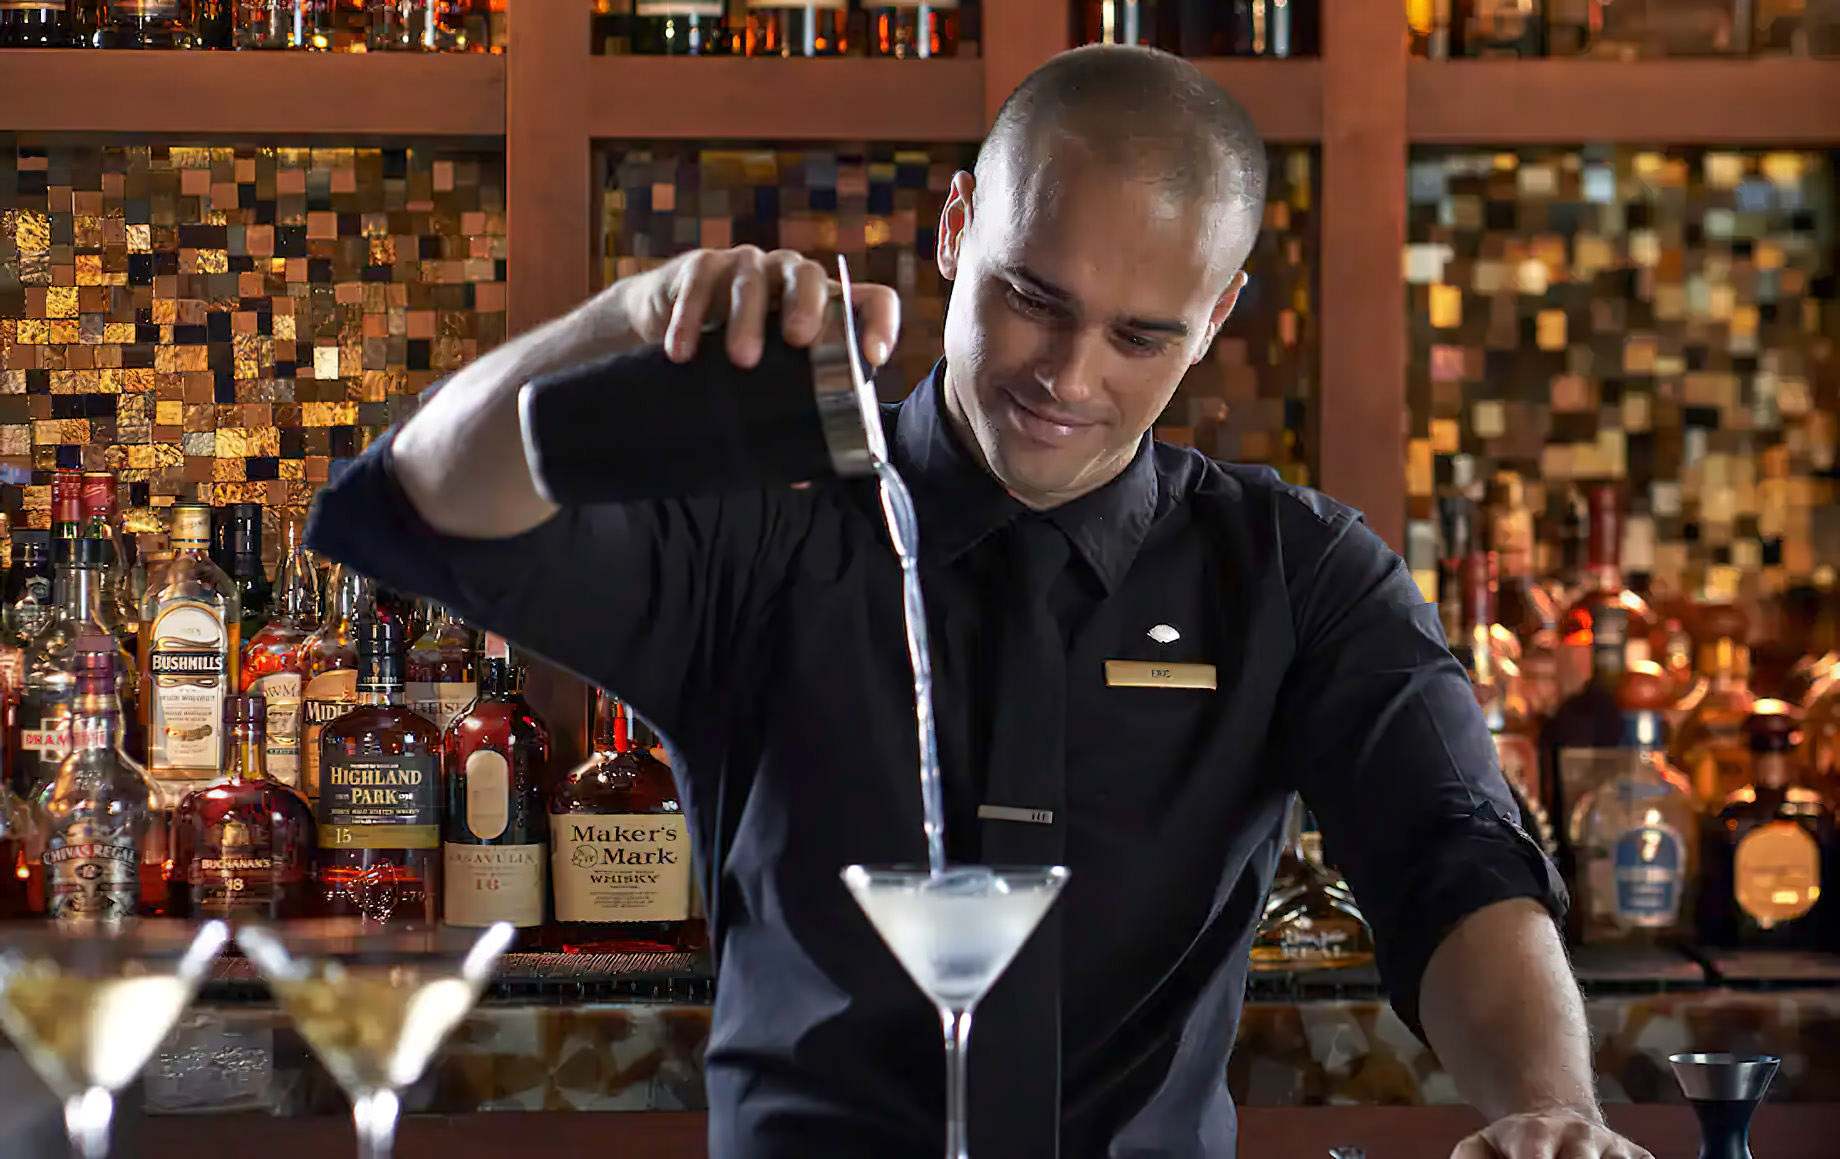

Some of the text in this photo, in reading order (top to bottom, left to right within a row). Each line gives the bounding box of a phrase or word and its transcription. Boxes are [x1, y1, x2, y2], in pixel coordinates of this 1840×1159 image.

[151, 654, 224, 671] BUSHMILLS
[305, 701, 356, 723] MIDL
[330, 766, 423, 786] HIGHLAND
[351, 787, 399, 805] PARK
[335, 828, 352, 844] 15
[569, 824, 678, 843] Maker's
[42, 844, 135, 865] CHIVAS REGAL
[448, 853, 535, 865] AVULIN
[600, 847, 678, 866] Mark
[201, 858, 271, 871] BUCHANAN'S
[590, 874, 660, 884] WHISKY
